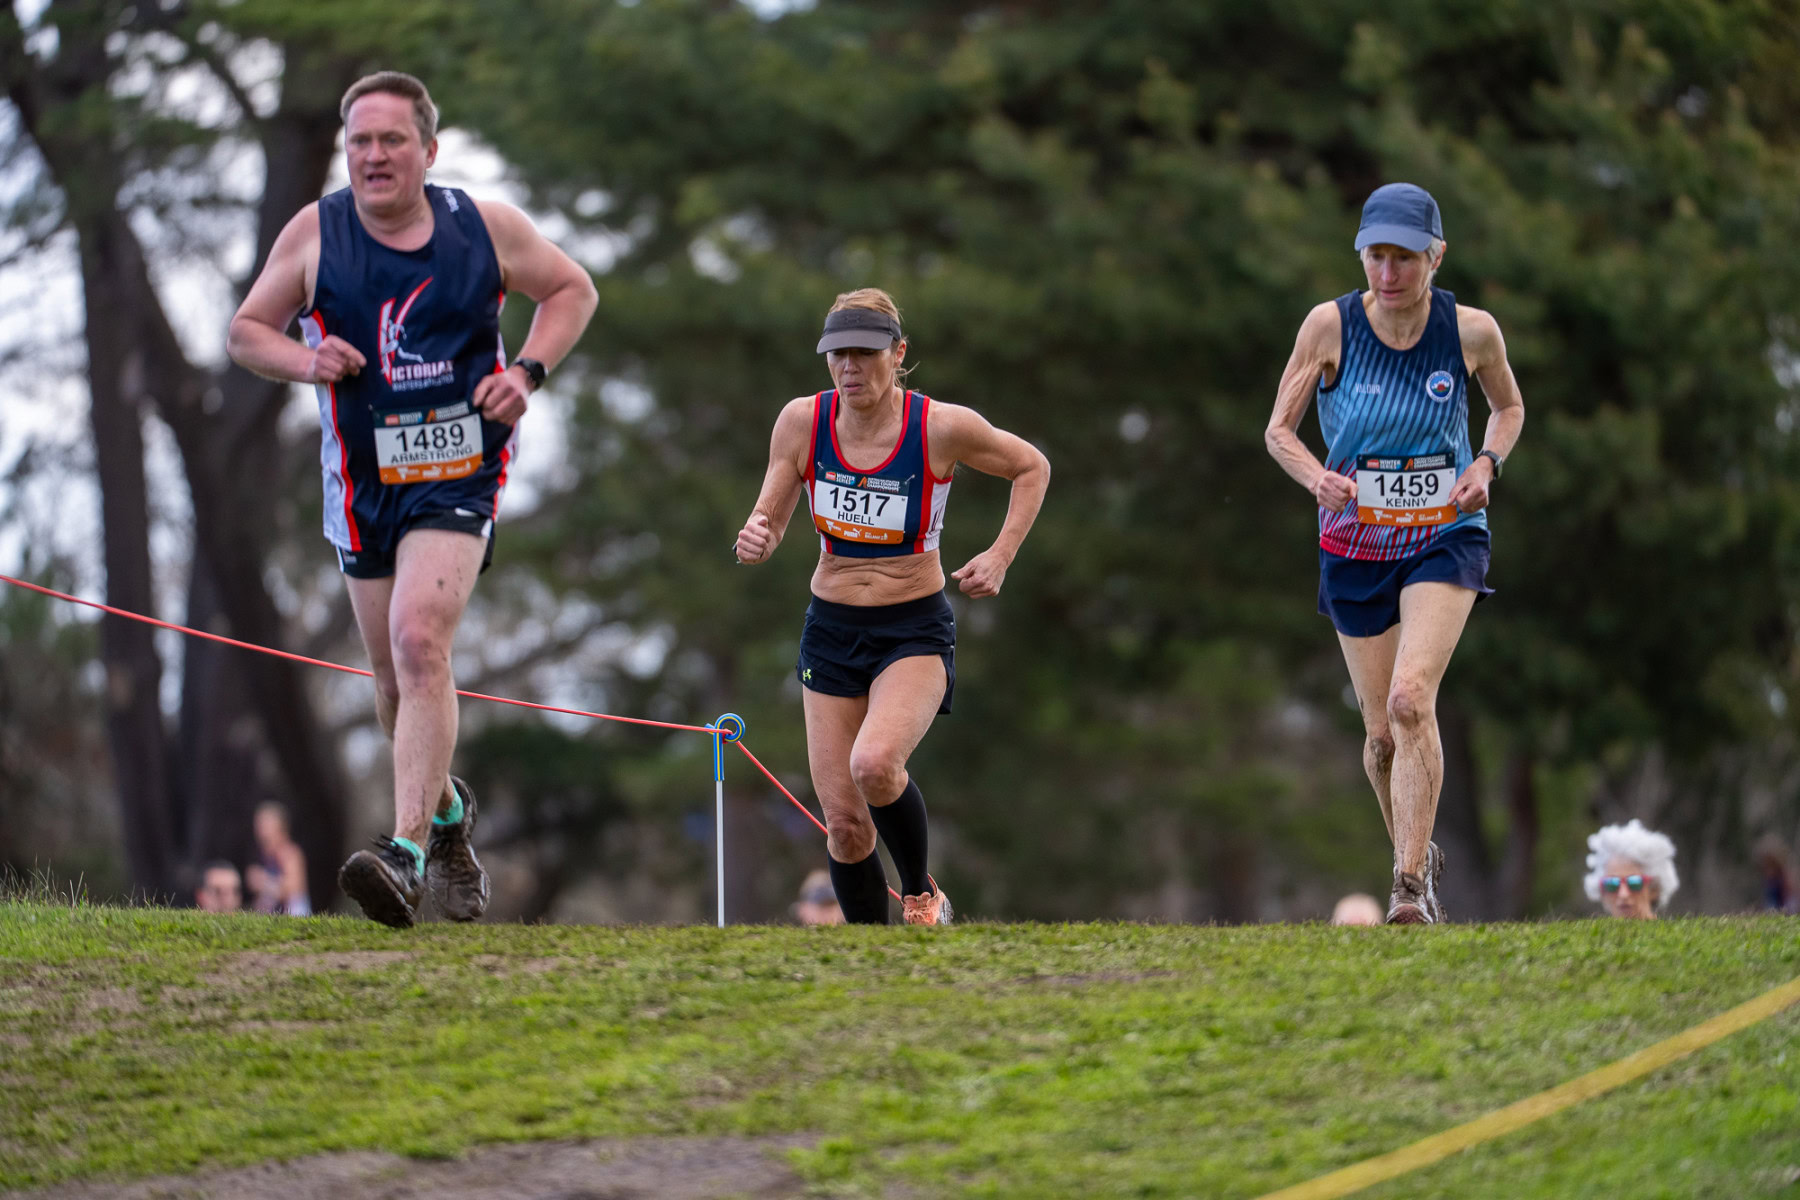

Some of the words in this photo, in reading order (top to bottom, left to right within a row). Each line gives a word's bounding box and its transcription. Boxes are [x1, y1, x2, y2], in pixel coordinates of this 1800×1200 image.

[396, 424, 464, 453] 1489
[391, 445, 473, 464] ARMSTRONG
[836, 472, 855, 480] WINTER
[1374, 472, 1439, 497] 1459
[830, 487, 890, 517] 1517
[1386, 497, 1428, 508] KENNY
[838, 511, 874, 525] HUELL
